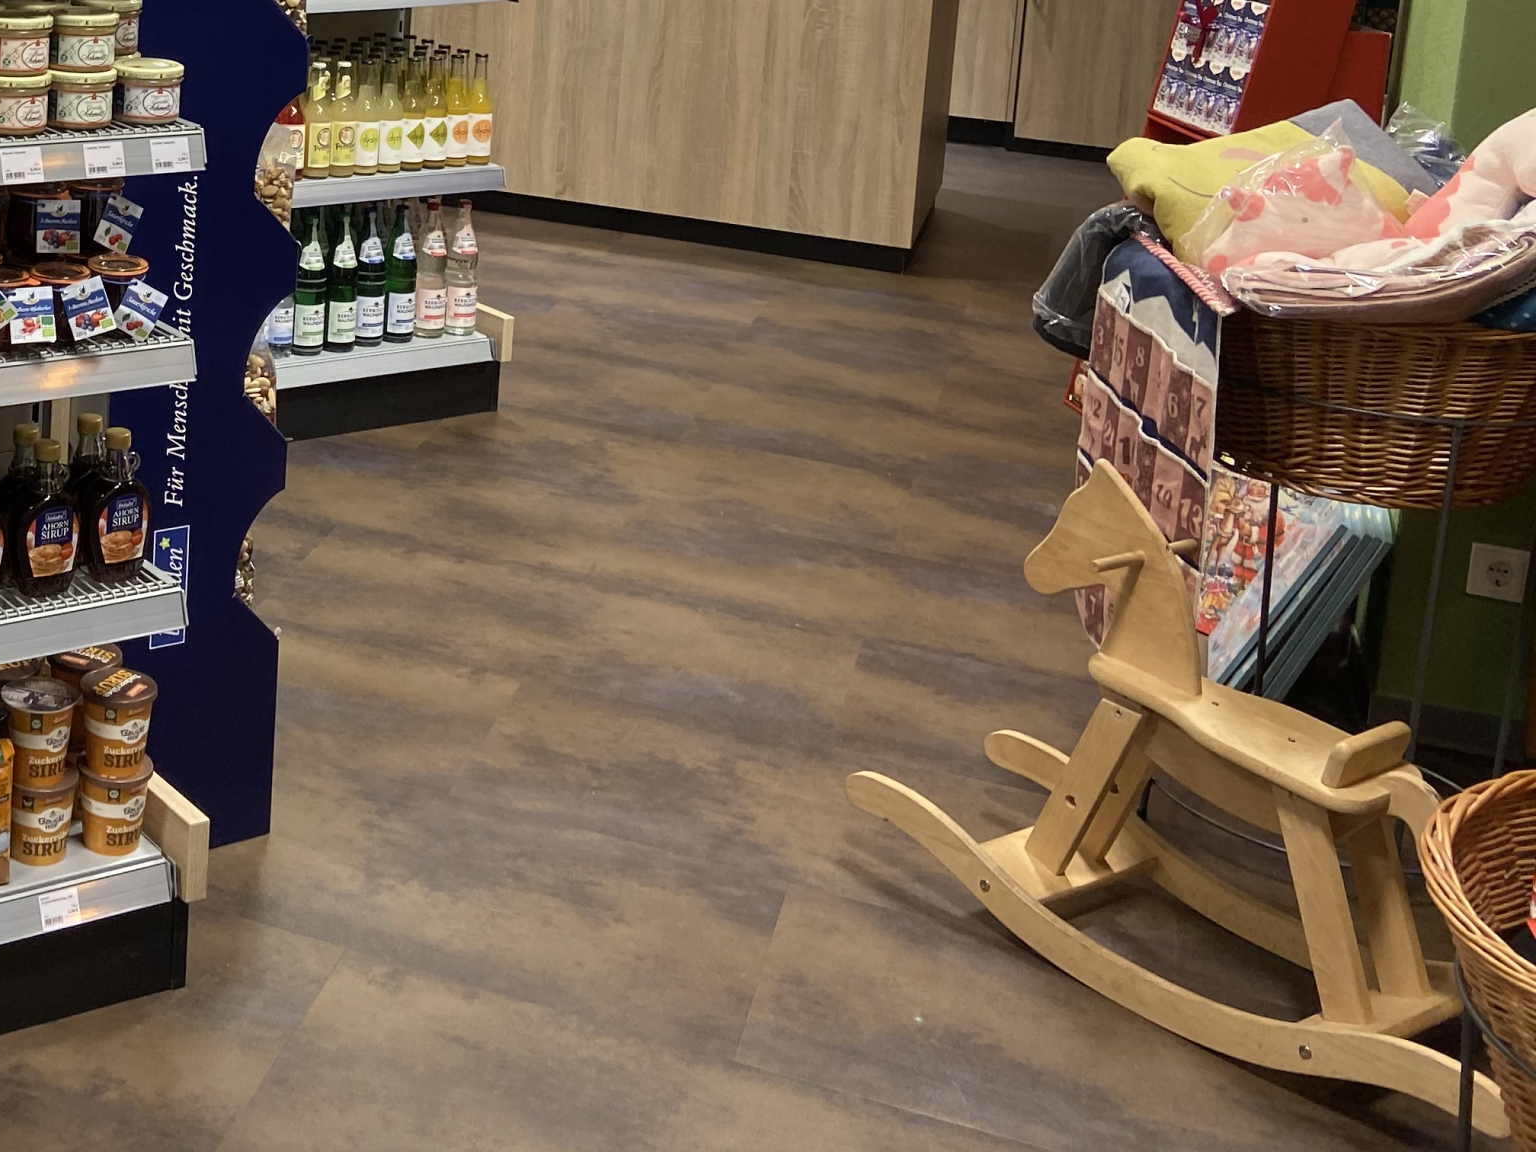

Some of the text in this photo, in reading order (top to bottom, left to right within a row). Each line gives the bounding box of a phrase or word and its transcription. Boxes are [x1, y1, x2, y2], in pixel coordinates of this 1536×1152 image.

[173, 175, 198, 301] Geschmack.
[1135, 346, 1144, 367] 8
[1167, 392, 1178, 418] 6
[1196, 397, 1207, 418] 7
[166, 382, 188, 460] Mensch
[165, 467, 185, 508] Für
[112, 513, 140, 527] SIRUP
[113, 506, 140, 519] AHORN
[1180, 498, 1203, 538] 13
[41, 527, 70, 540] SIRUP
[42, 520, 69, 531] AHORN
[104, 750, 144, 769] SIRU
[22, 837, 66, 857] SIRU
